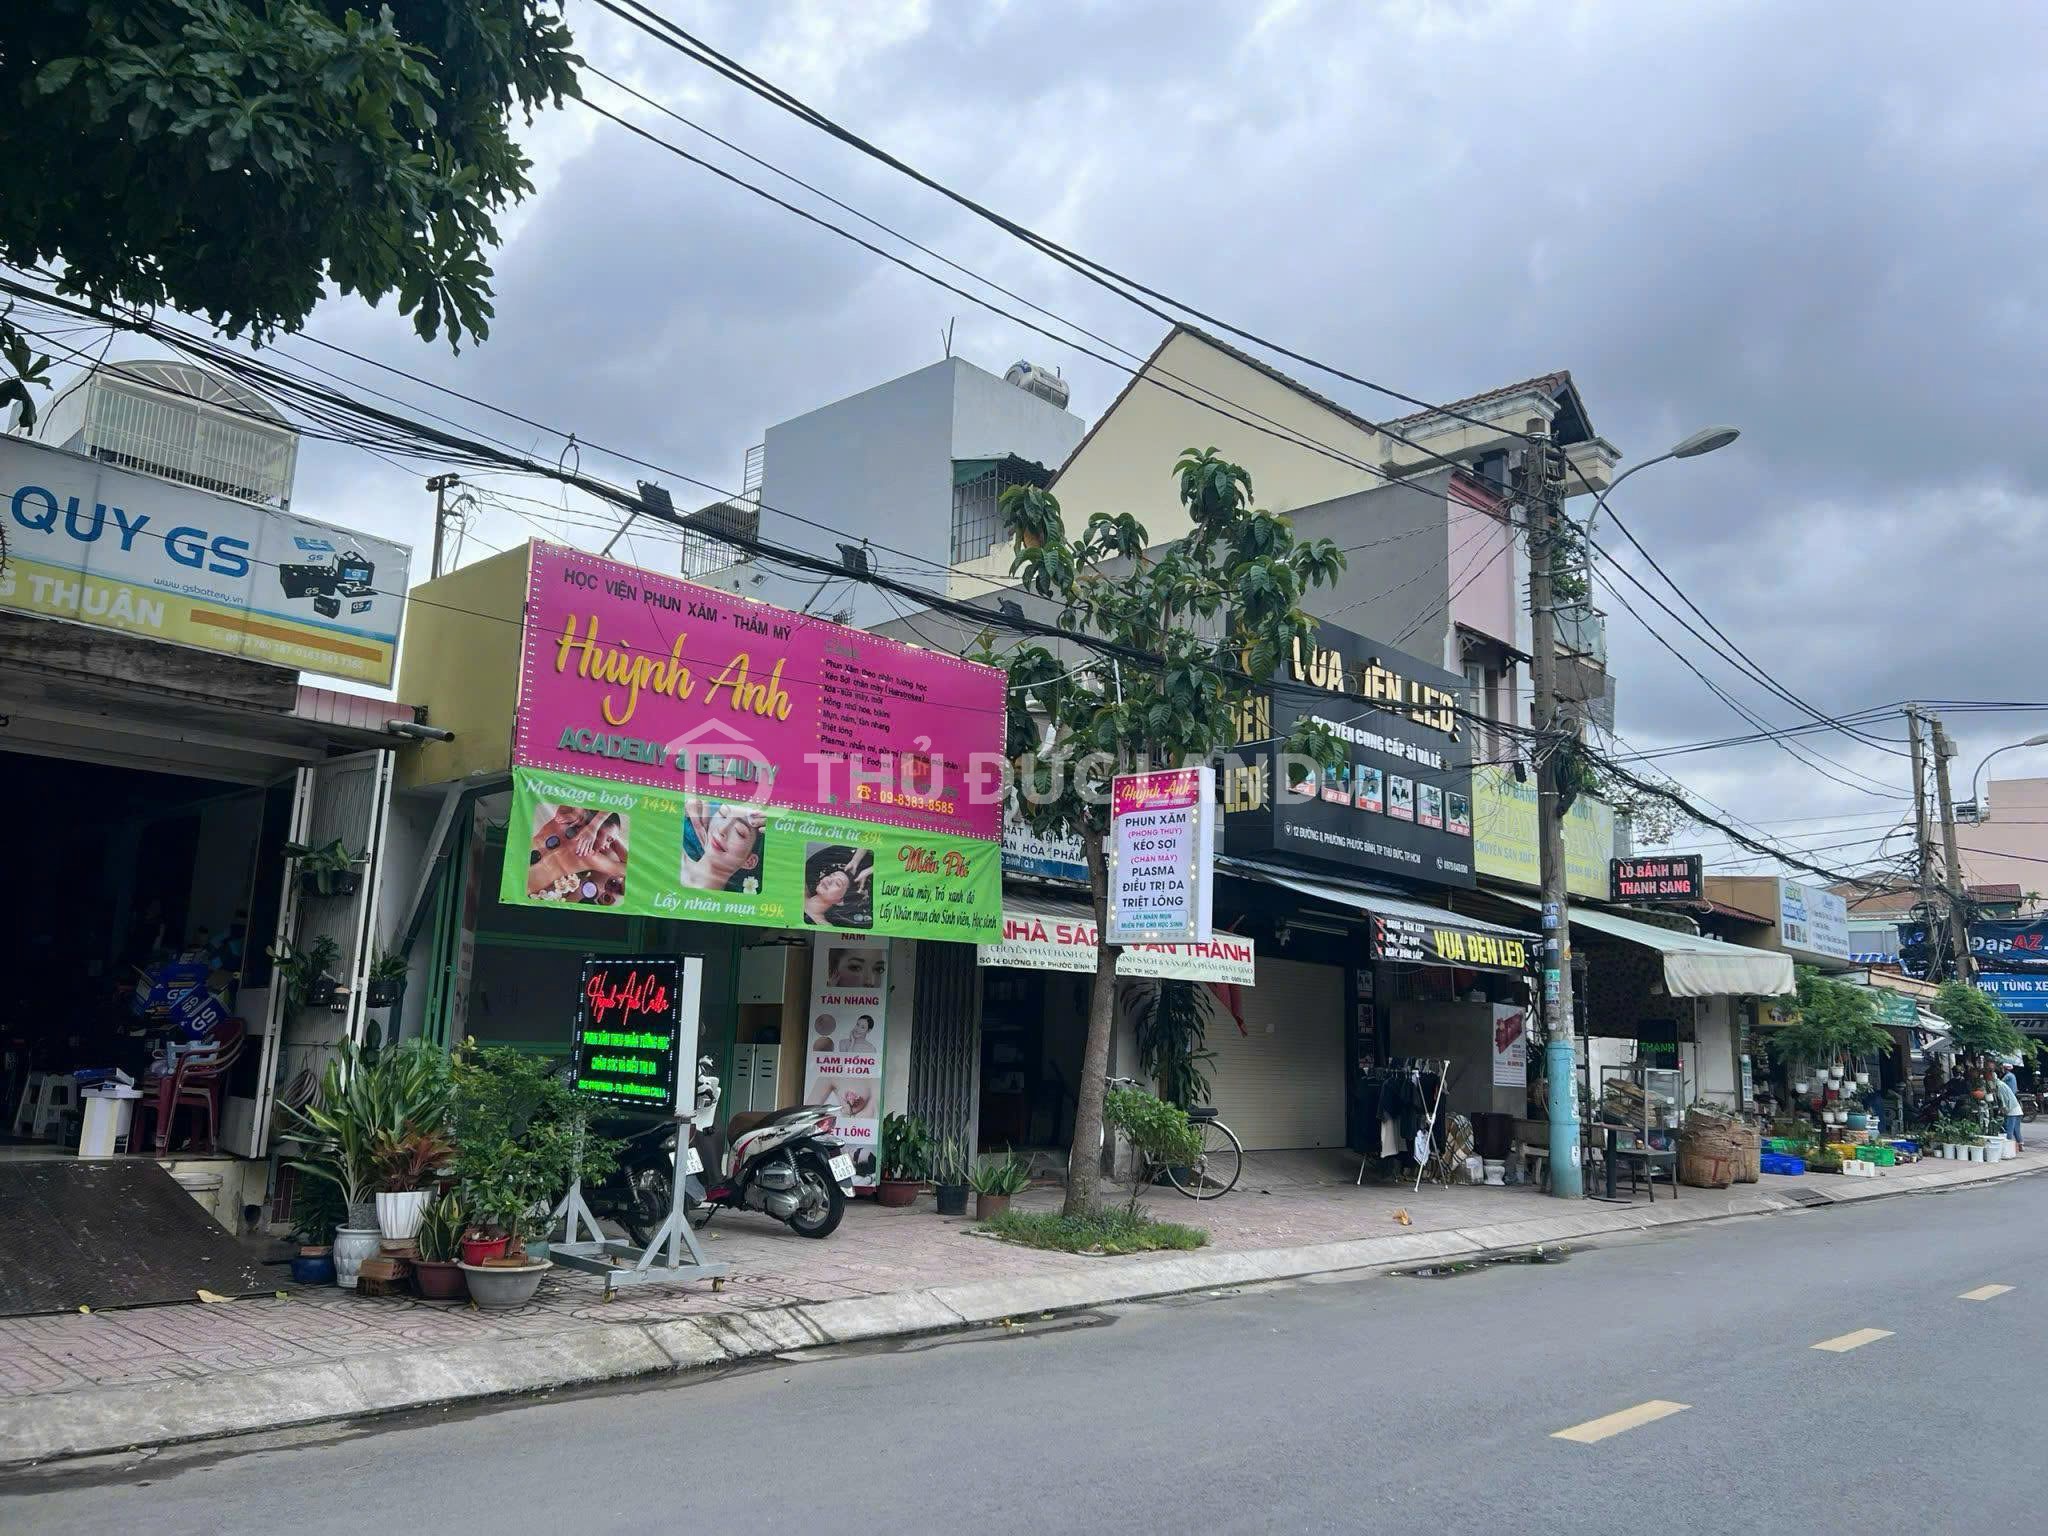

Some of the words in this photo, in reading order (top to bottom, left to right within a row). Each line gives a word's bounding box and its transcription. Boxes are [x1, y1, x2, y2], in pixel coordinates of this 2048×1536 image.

[11, 485, 151, 552] QUY
[164, 526, 249, 578] GS
[153, 577, 244, 604] www.gsbattery.vn
[563, 567, 598, 591] HỌC
[605, 579, 637, 602] VIỆN
[643, 590, 682, 613] PHUN
[687, 601, 718, 623] XĂM
[733, 612, 769, 636] THẨM
[555, 613, 696, 727] Huỳnh
[703, 652, 793, 721] Anh
[1411, 680, 1454, 733] LED
[1355, 728, 1384, 752] CUNG
[1384, 737, 1406, 758] CẤP
[557, 725, 668, 767] ACADEMY
[697, 750, 780, 786] BEAUTY
[526, 778, 597, 803] Massage
[600, 789, 638, 810] body
[641, 794, 679, 815] 149k
[1225, 765, 1262, 813] LED
[879, 790, 955, 815] 09-8383-8585
[1125, 816, 1155, 827] PHUN
[1159, 812, 1186, 825] XĂM
[1128, 828, 1158, 839] (PHONG
[1133, 838, 1154, 851] KÉO
[1132, 865, 1175, 877] PLASMA
[1619, 862, 1634, 878] LÒ
[1636, 861, 1669, 878] BÁNH
[1673, 860, 1689, 876] MÌ
[881, 880, 900, 897] Laser
[1150, 881, 1165, 893] TRỊ
[1168, 880, 1184, 890] DA
[1619, 881, 1657, 895] THANH
[1659, 880, 1691, 894] SANG
[653, 888, 681, 913] Lấy
[684, 897, 721, 914] nhân
[724, 902, 757, 918] mụn
[759, 903, 785, 918] 99k
[1122, 895, 1149, 910] TRIỆT
[1152, 894, 1184, 907] LÔNG
[928, 908, 940, 924] cho
[940, 908, 956, 925] Sinh
[1434, 929, 1466, 961] VUA
[1466, 931, 1499, 965] ĐÈN
[1498, 939, 1525, 968] LED
[1976, 980, 1999, 993] PHỤ
[2001, 978, 2033, 992] TÙNG
[844, 995, 879, 1006] NHANG
[847, 1066, 870, 1075] HOA
[844, 1125, 871, 1138] LÔNG
